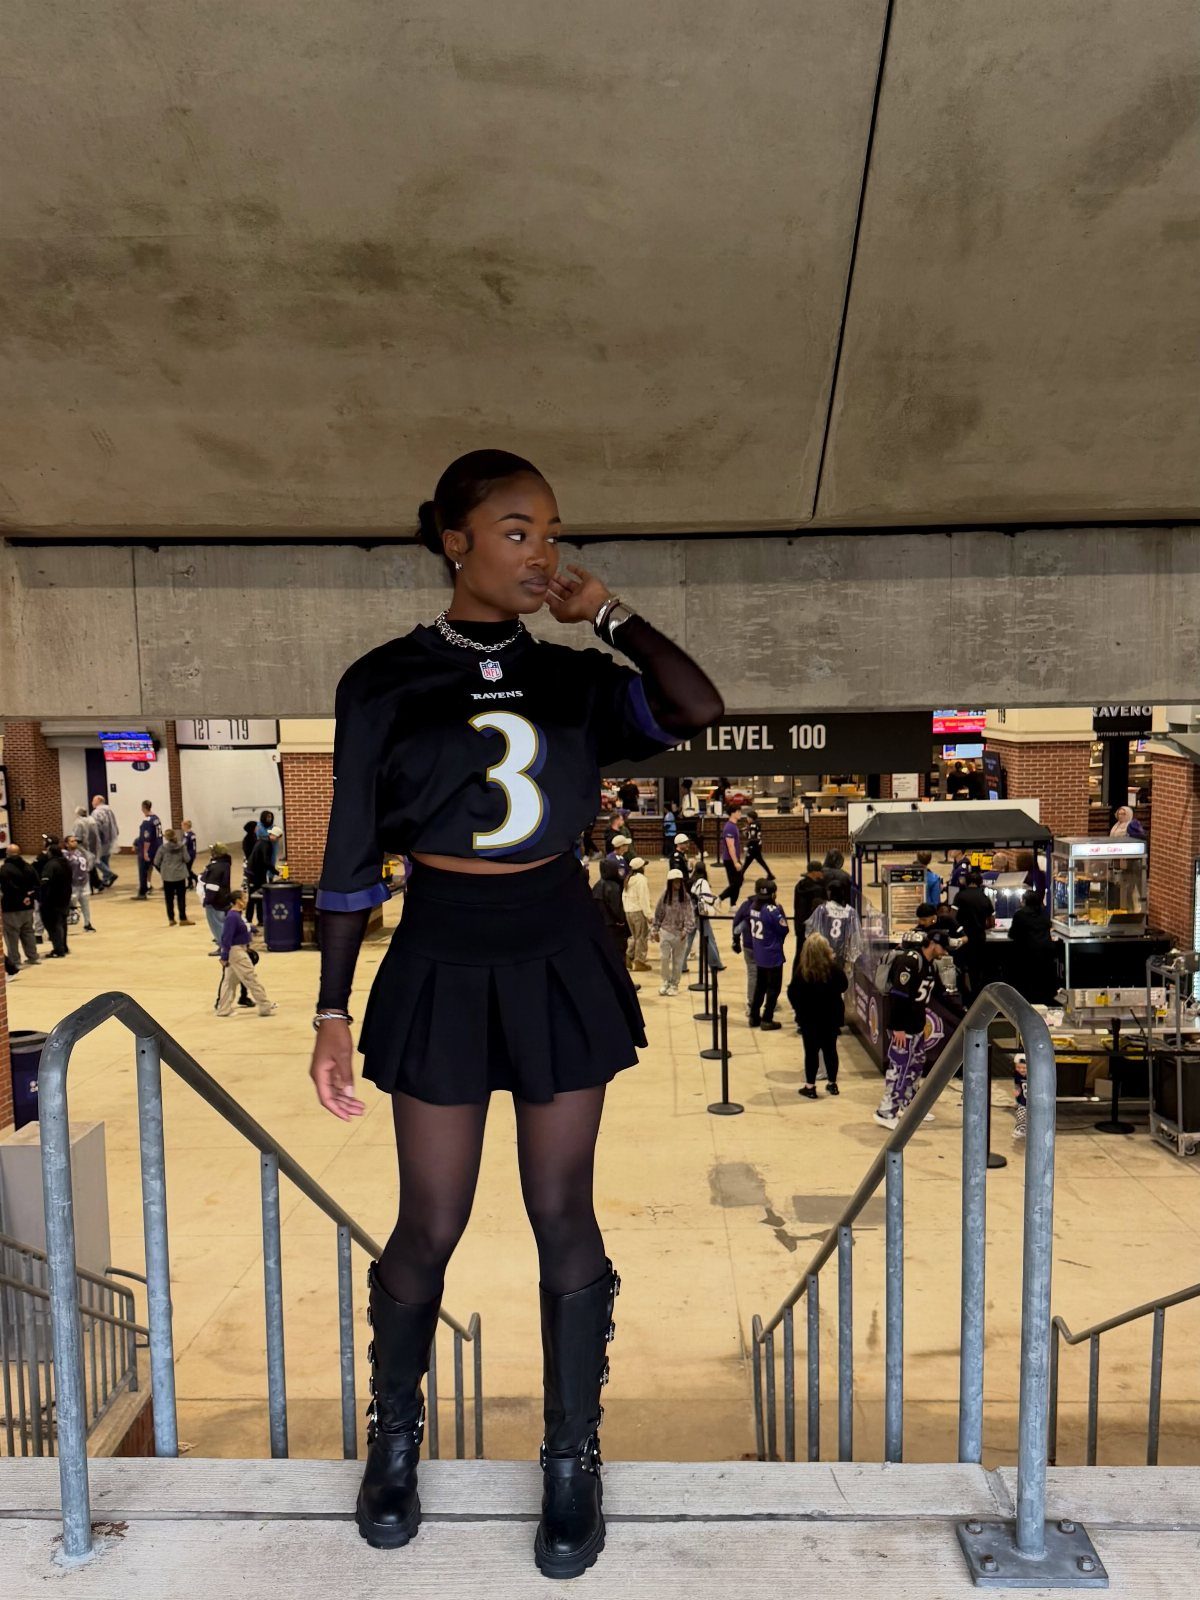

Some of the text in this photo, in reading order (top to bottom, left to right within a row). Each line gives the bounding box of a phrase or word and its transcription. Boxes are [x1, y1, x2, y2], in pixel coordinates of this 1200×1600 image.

[484, 668, 501, 678] NFL
[470, 690, 524, 700] RAVENS
[706, 725, 774, 751] LEVEL
[788, 724, 827, 750] 100
[468, 710, 549, 854] 3
[830, 918, 842, 939] 8
